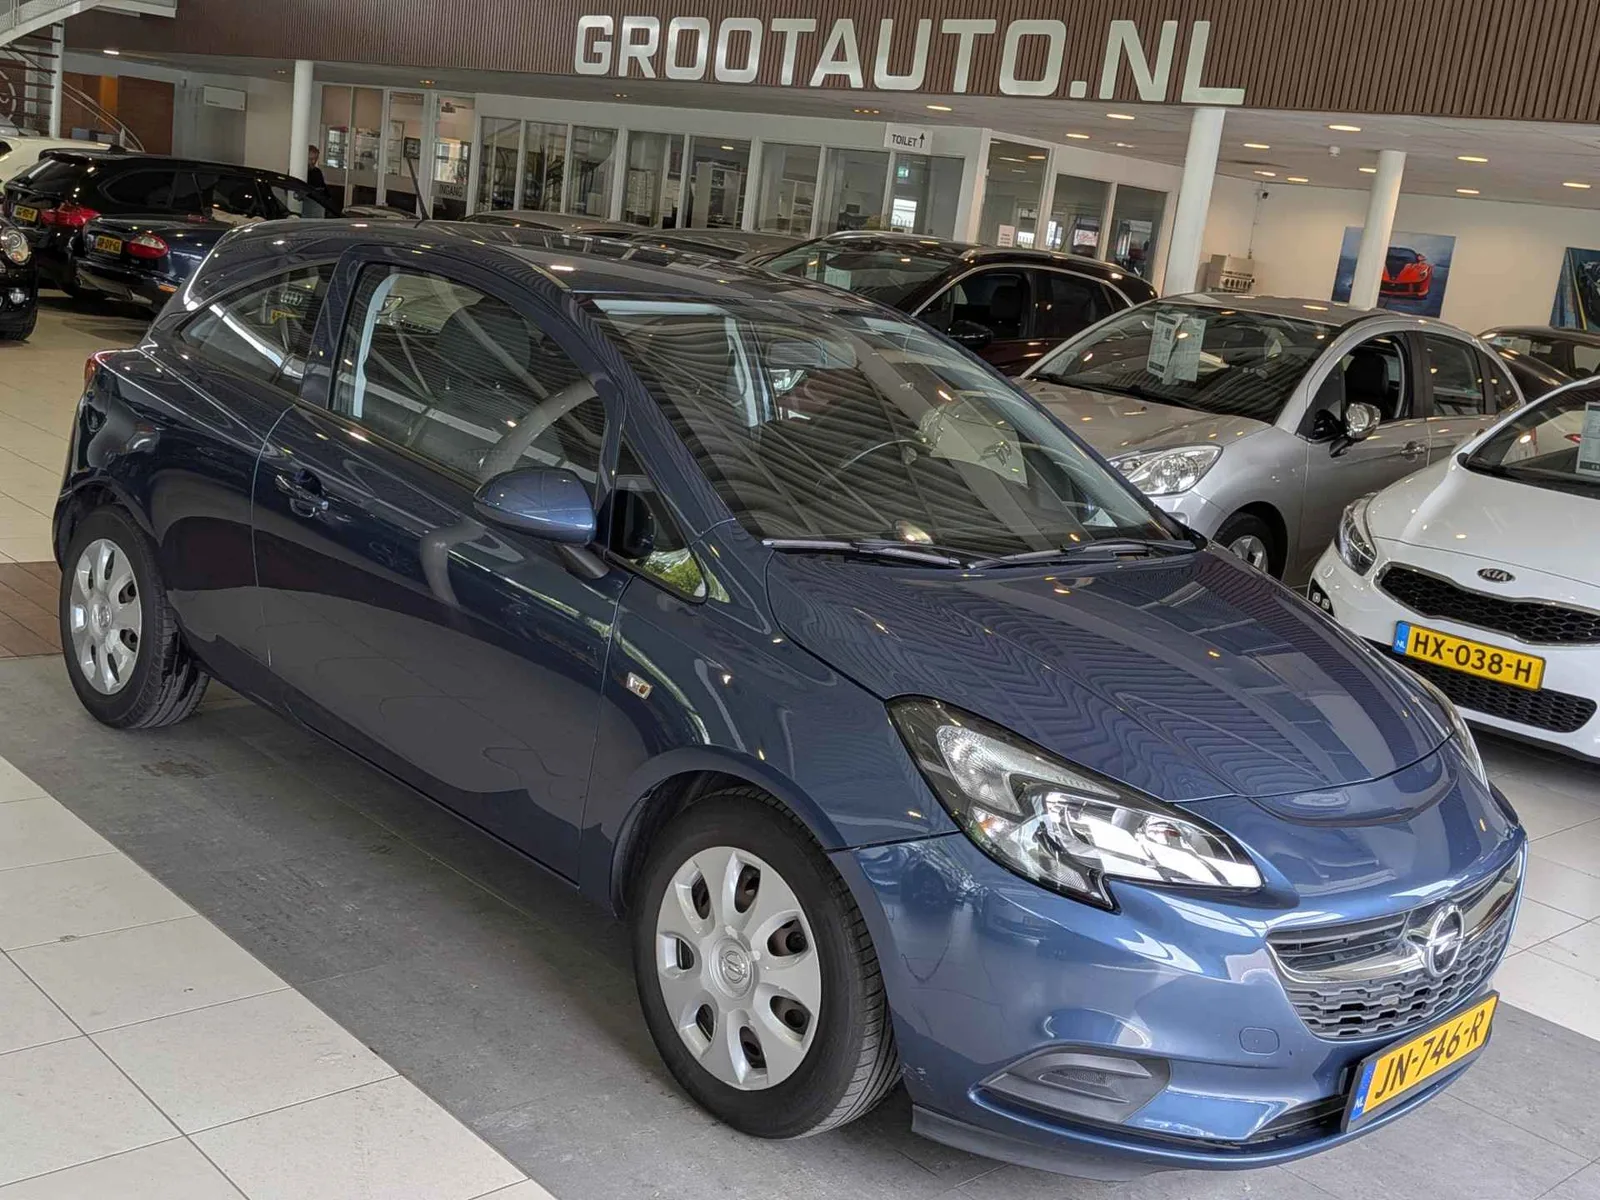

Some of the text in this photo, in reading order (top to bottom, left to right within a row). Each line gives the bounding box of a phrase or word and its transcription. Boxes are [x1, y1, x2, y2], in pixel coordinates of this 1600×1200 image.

[574, 14, 1246, 105] GROOTAUTO.NL
[892, 133, 917, 147] TOILET
[1481, 568, 1508, 581] KIA
[1396, 639, 1406, 649] NL
[1413, 632, 1533, 684] HX-038-H
[1374, 1008, 1486, 1100] JN-746-R
